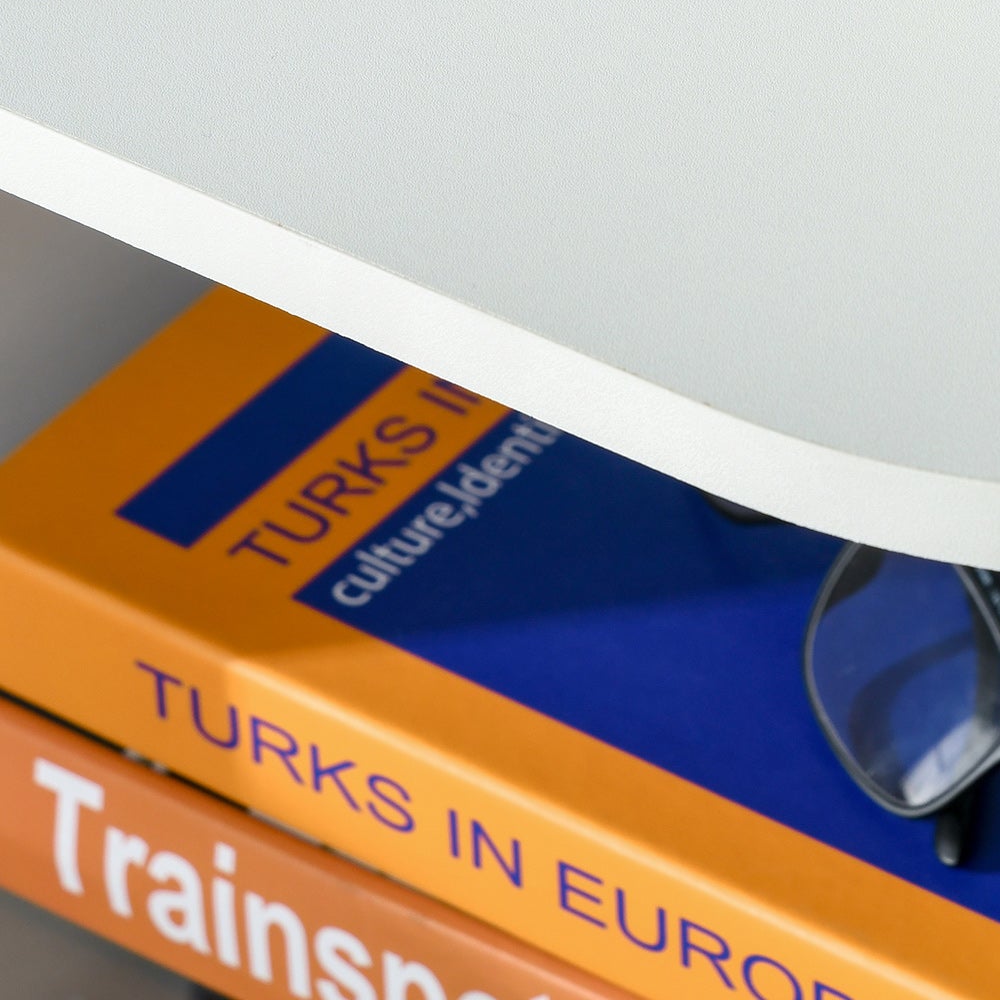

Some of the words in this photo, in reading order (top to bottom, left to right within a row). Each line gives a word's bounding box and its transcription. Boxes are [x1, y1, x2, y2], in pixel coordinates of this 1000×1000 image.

[227, 415, 438, 570] TURKS
[33, 756, 552, 1000] Trains
[134, 659, 416, 834] TURKS
[448, 807, 523, 890] IN
